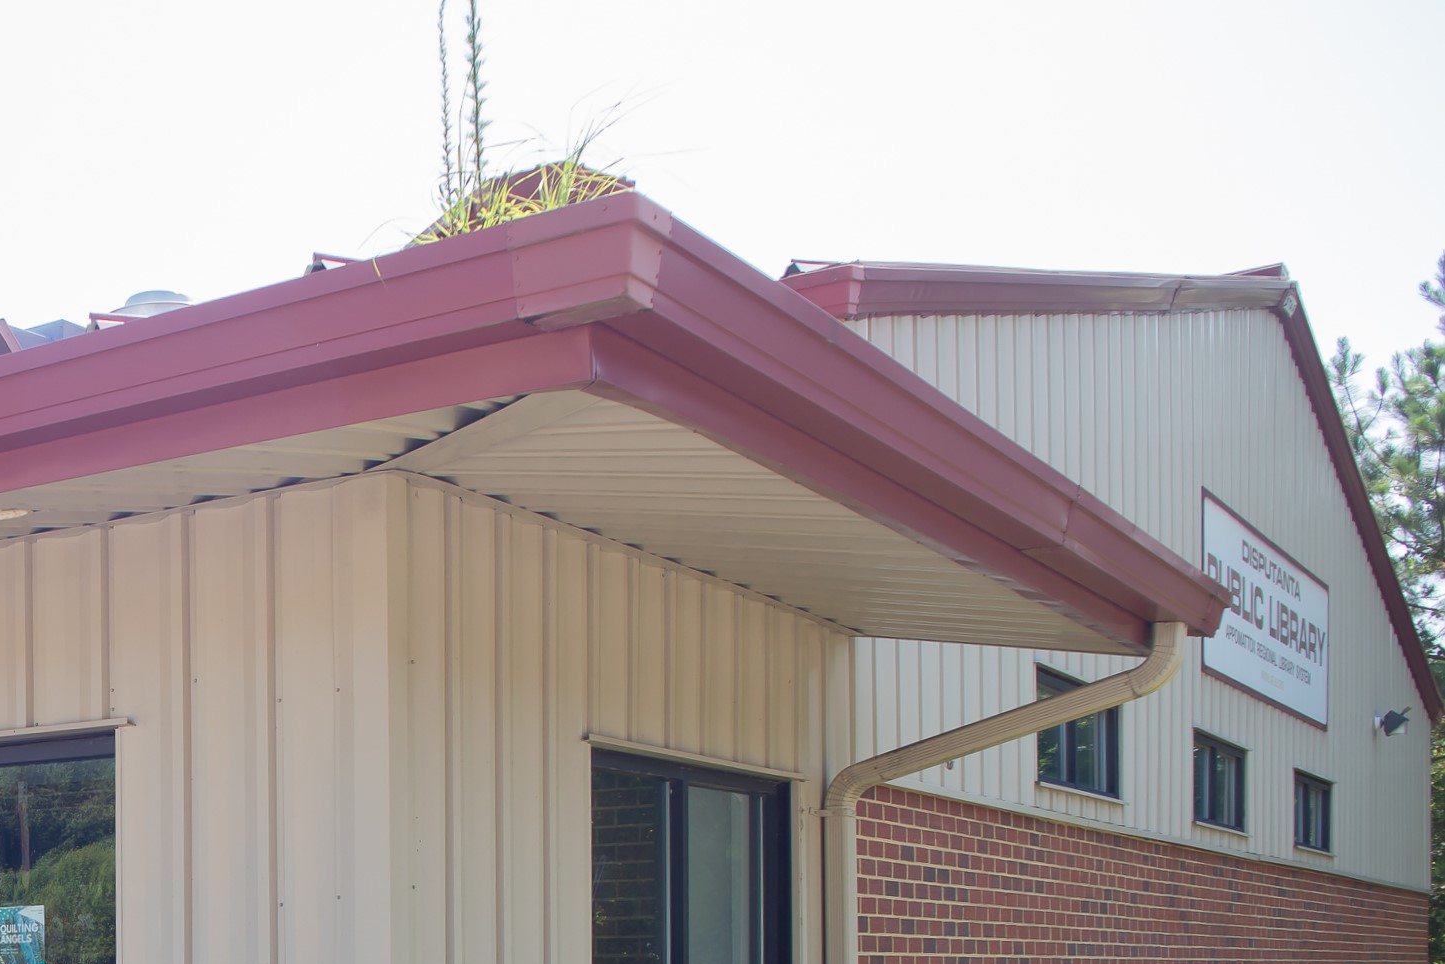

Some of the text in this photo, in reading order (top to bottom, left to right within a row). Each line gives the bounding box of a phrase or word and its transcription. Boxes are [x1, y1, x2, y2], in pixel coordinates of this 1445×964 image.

[1242, 539, 1301, 602] DISPUTANTA
[1225, 623, 1256, 655] APPOMATTOX
[1256, 641, 1277, 668] REGIONAL
[1278, 655, 1295, 676] LIBRARY
[1296, 664, 1311, 685] SYSTEM
[1269, 595, 1326, 667] LIBRARY
[0, 923, 39, 935] QUILTING
[0, 933, 32, 944] ANGELS
